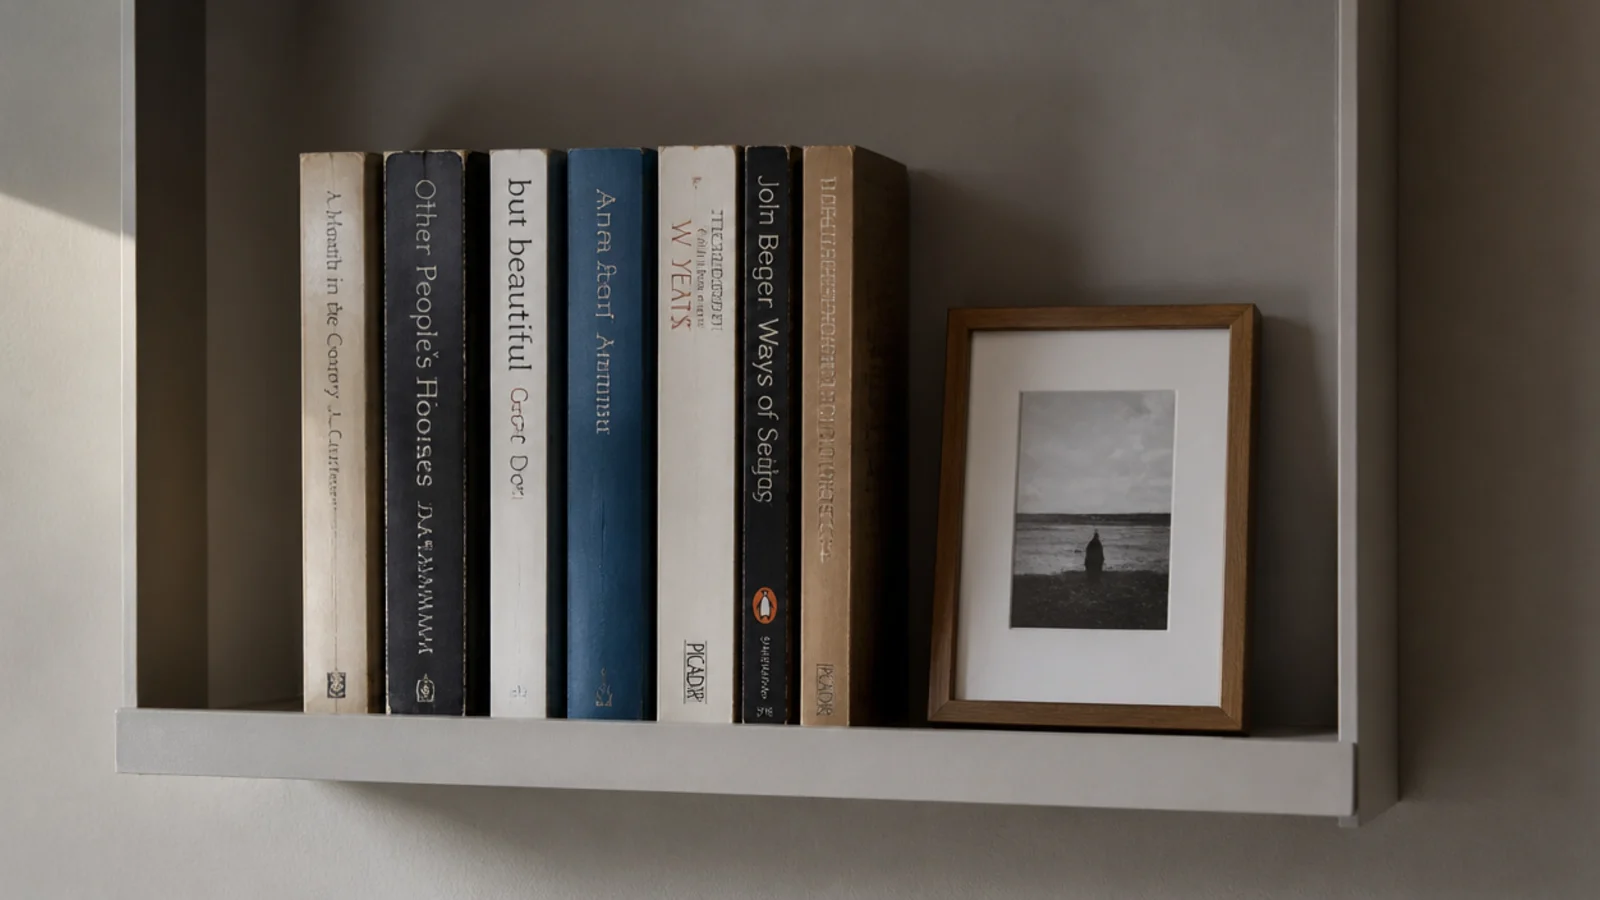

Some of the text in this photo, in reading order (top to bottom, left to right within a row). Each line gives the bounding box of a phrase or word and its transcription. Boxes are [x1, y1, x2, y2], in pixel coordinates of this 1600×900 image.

[415, 179, 438, 256] Other
[508, 178, 533, 227] but
[326, 278, 344, 295] in
[508, 237, 534, 372] beautiful
[752, 234, 780, 309] Beger
[409, 265, 439, 369] People's
[752, 317, 780, 387] Ways
[757, 395, 780, 422] of
